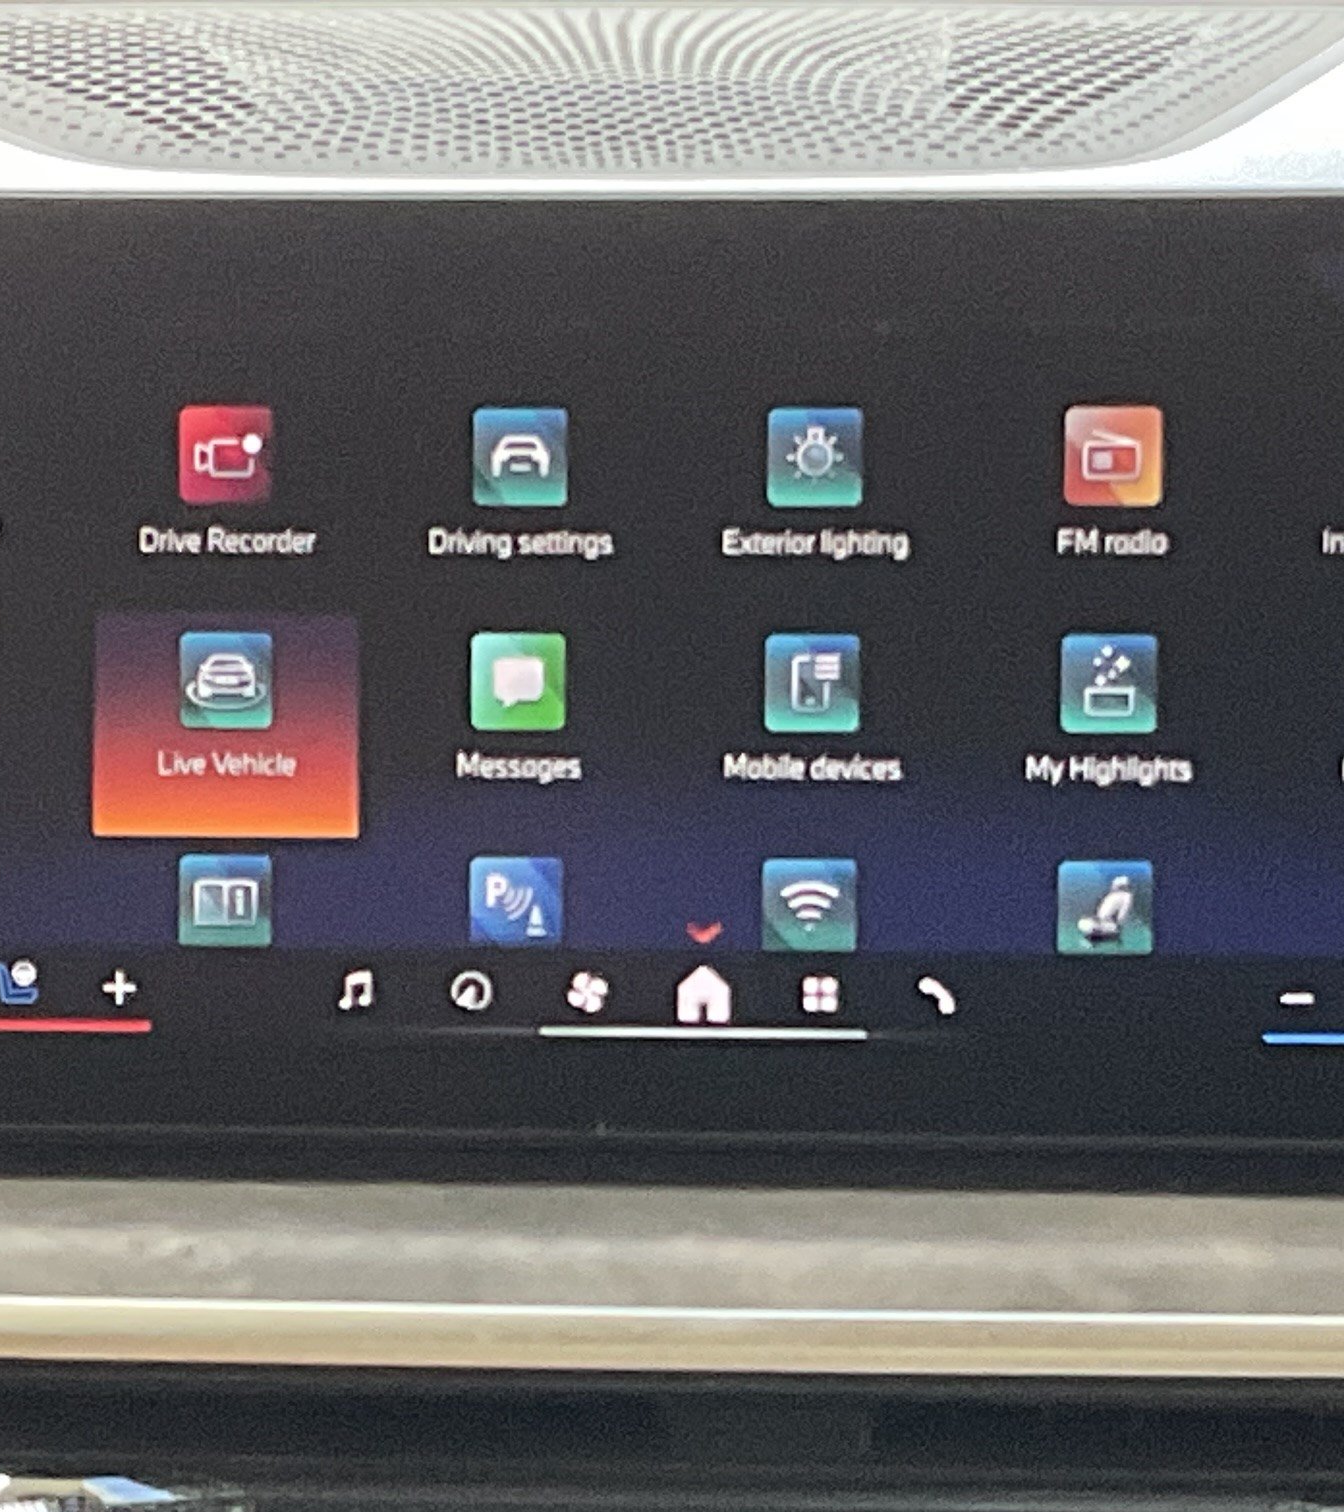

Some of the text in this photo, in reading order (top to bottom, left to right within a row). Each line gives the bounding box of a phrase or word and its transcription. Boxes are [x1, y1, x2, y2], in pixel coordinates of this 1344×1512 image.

[139, 525, 318, 554] Drive Recorder
[428, 527, 614, 561] Driving settings
[722, 528, 911, 561] Exterior lighting
[1056, 529, 1169, 556] FM radio
[157, 750, 298, 777] Live Vehicle
[456, 752, 582, 784] Messages
[723, 752, 904, 782] Mobile devices
[1025, 754, 1193, 785] My Highlights
